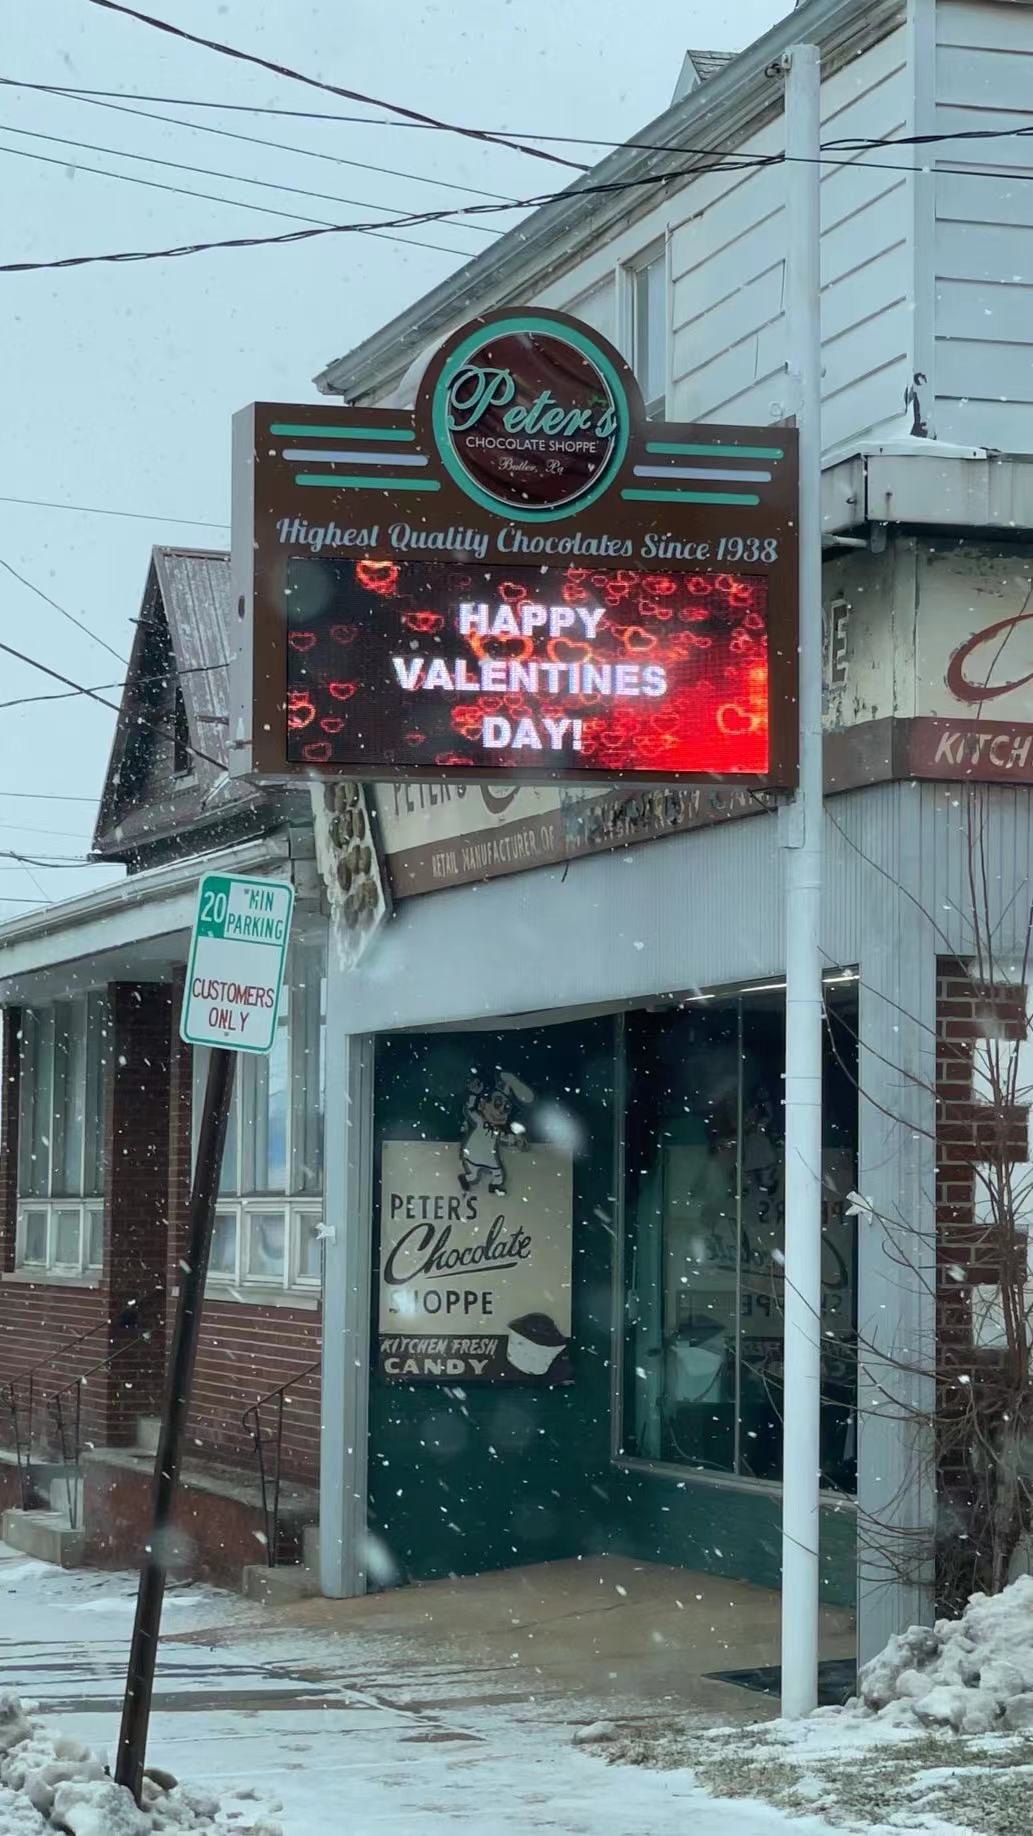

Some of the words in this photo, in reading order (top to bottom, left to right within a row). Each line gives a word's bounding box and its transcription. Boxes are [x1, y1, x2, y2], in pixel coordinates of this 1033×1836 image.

[466, 437, 545, 451] CHOCOLATE
[549, 440, 598, 453] SHOPPE
[276, 517, 379, 552] Highest
[388, 523, 489, 558] Quality
[496, 527, 633, 556] Chocolates
[640, 533, 709, 560] Since
[715, 537, 779, 563] 1938
[458, 603, 606, 639] HAPPY
[392, 657, 668, 697] VALENTINES
[482, 716, 583, 751] DAY!
[431, 851, 459, 878] RETAIL
[461, 829, 537, 872] MANUFACTURER
[540, 825, 555, 853] OF
[200, 891, 227, 924] 20
[249, 889, 274, 911] MIN
[226, 913, 283, 940] PARKING
[193, 978, 275, 1008] CUSTOMERS
[208, 1006, 250, 1032] ONLY
[391, 1193, 479, 1221] PETER'S
[384, 1215, 532, 1286] Chocolate
[380, 1337, 448, 1355] KITCHEN
[450, 1338, 499, 1356] FRESH
[384, 1357, 489, 1375] CANDY
